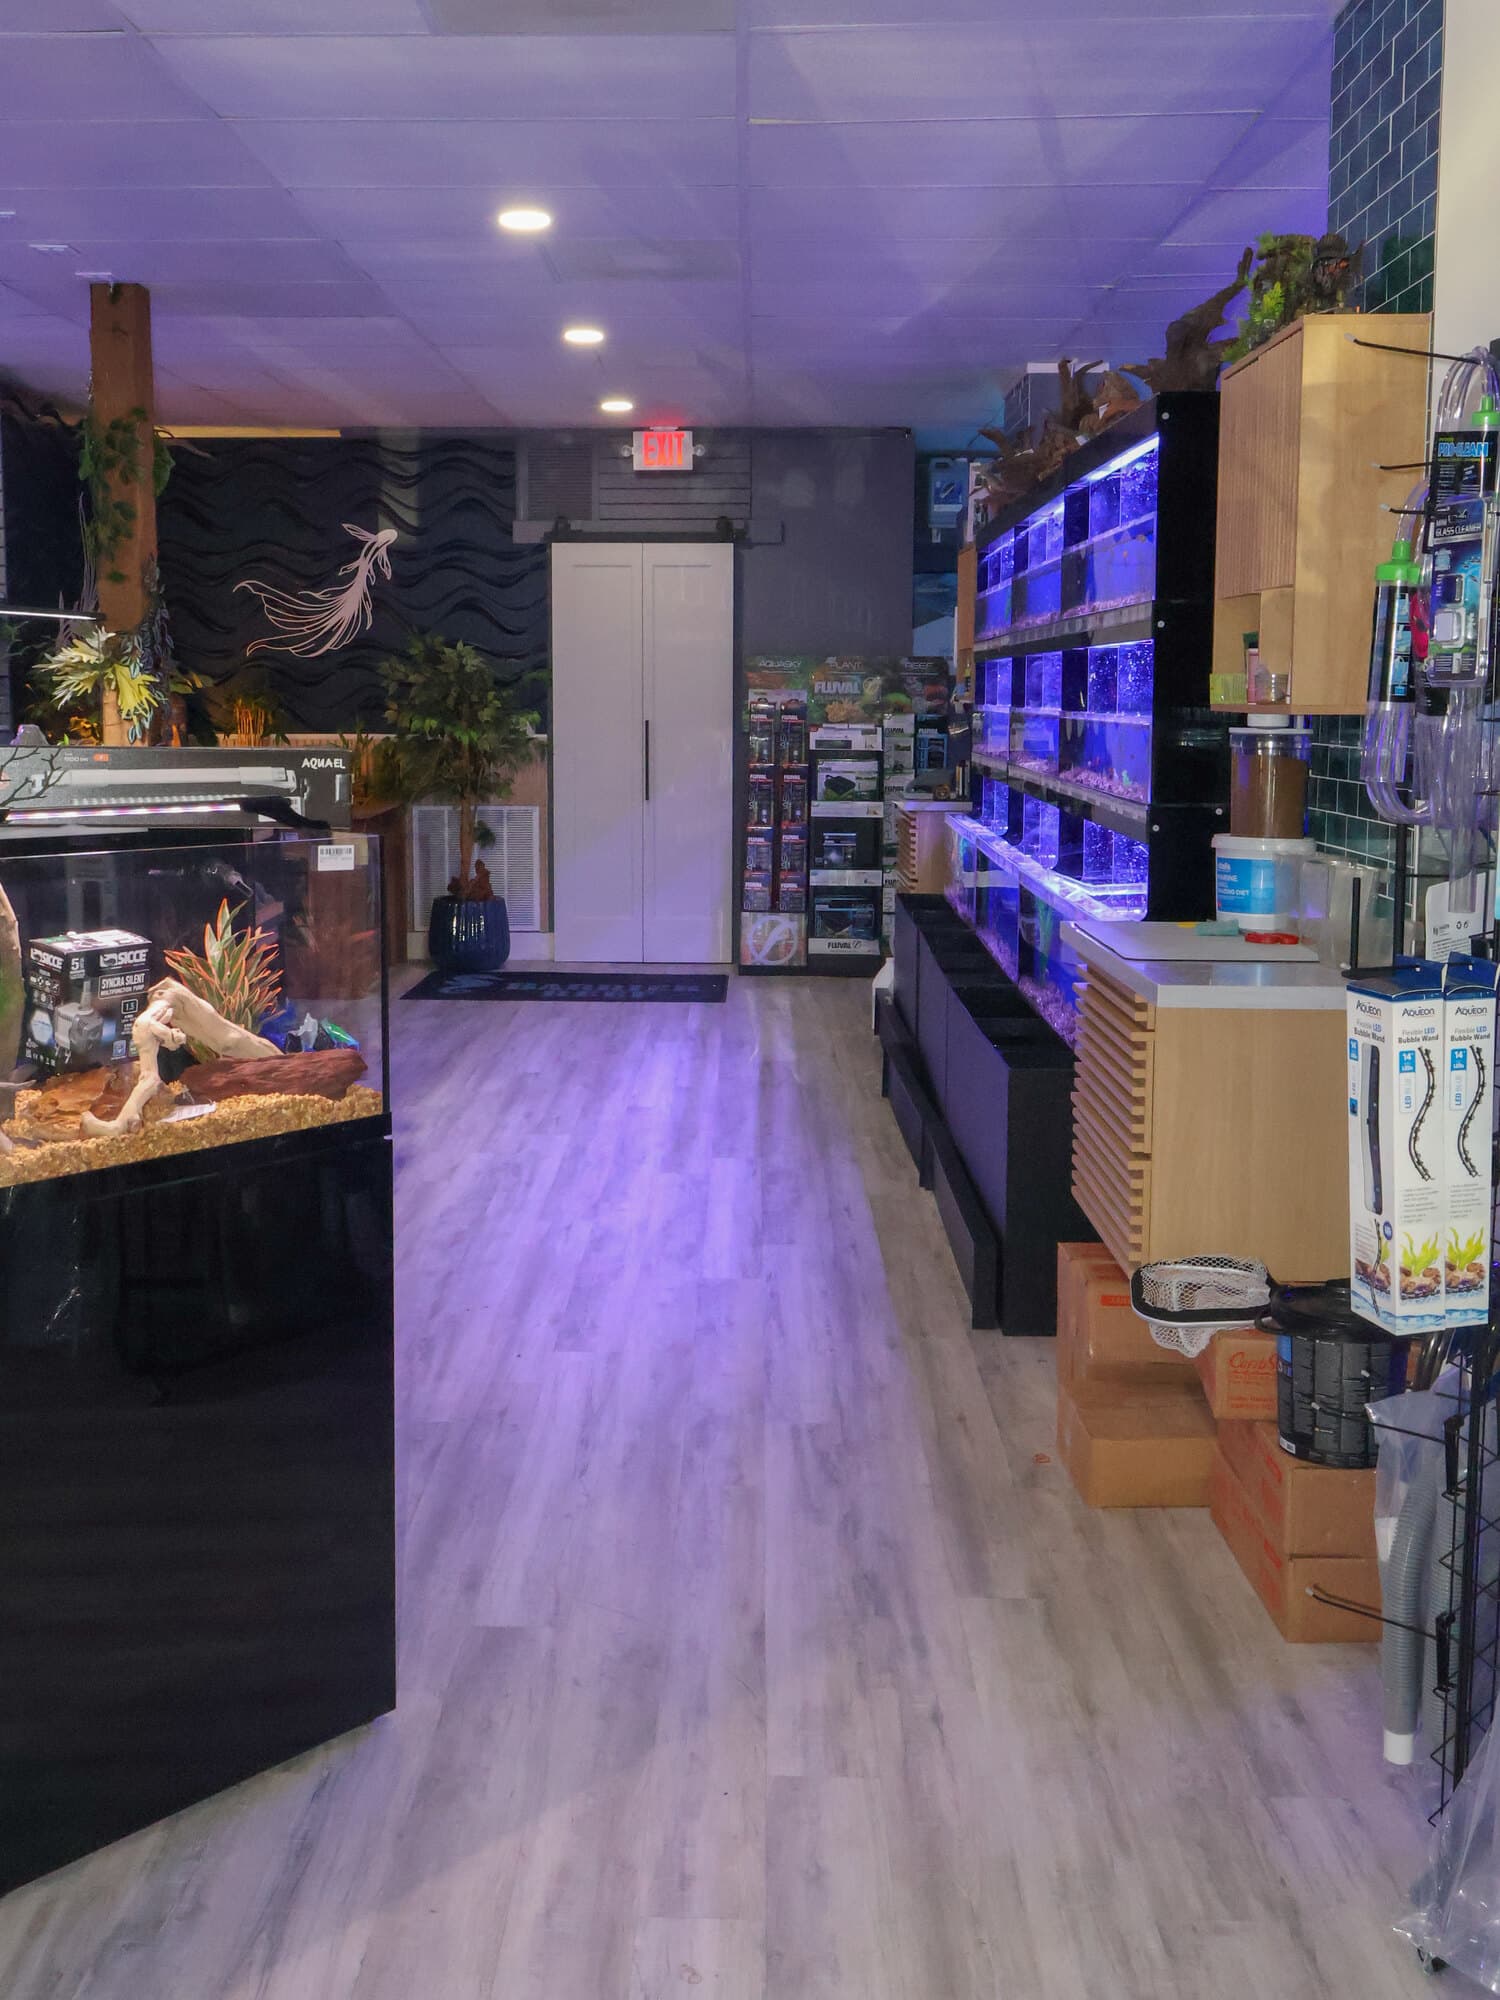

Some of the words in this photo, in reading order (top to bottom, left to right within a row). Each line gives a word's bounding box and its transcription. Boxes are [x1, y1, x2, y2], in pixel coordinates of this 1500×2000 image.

[643, 432, 685, 466] EXIT
[1436, 526, 1455, 537] GLASS
[814, 681, 861, 695] FLUVAL
[301, 758, 346, 769] AQUAEL
[39, 952, 65, 970] SICCE
[118, 948, 149, 966] SICCE
[101, 976, 125, 990] SYNCRA
[125, 973, 146, 985] SILENT
[1476, 1025, 1487, 1033] LED
[1398, 1036, 1420, 1044] Bubble
[1421, 1034, 1439, 1042] Wand
[1450, 1034, 1472, 1042] Bubble
[1229, 1351, 1279, 1371] CaribS
